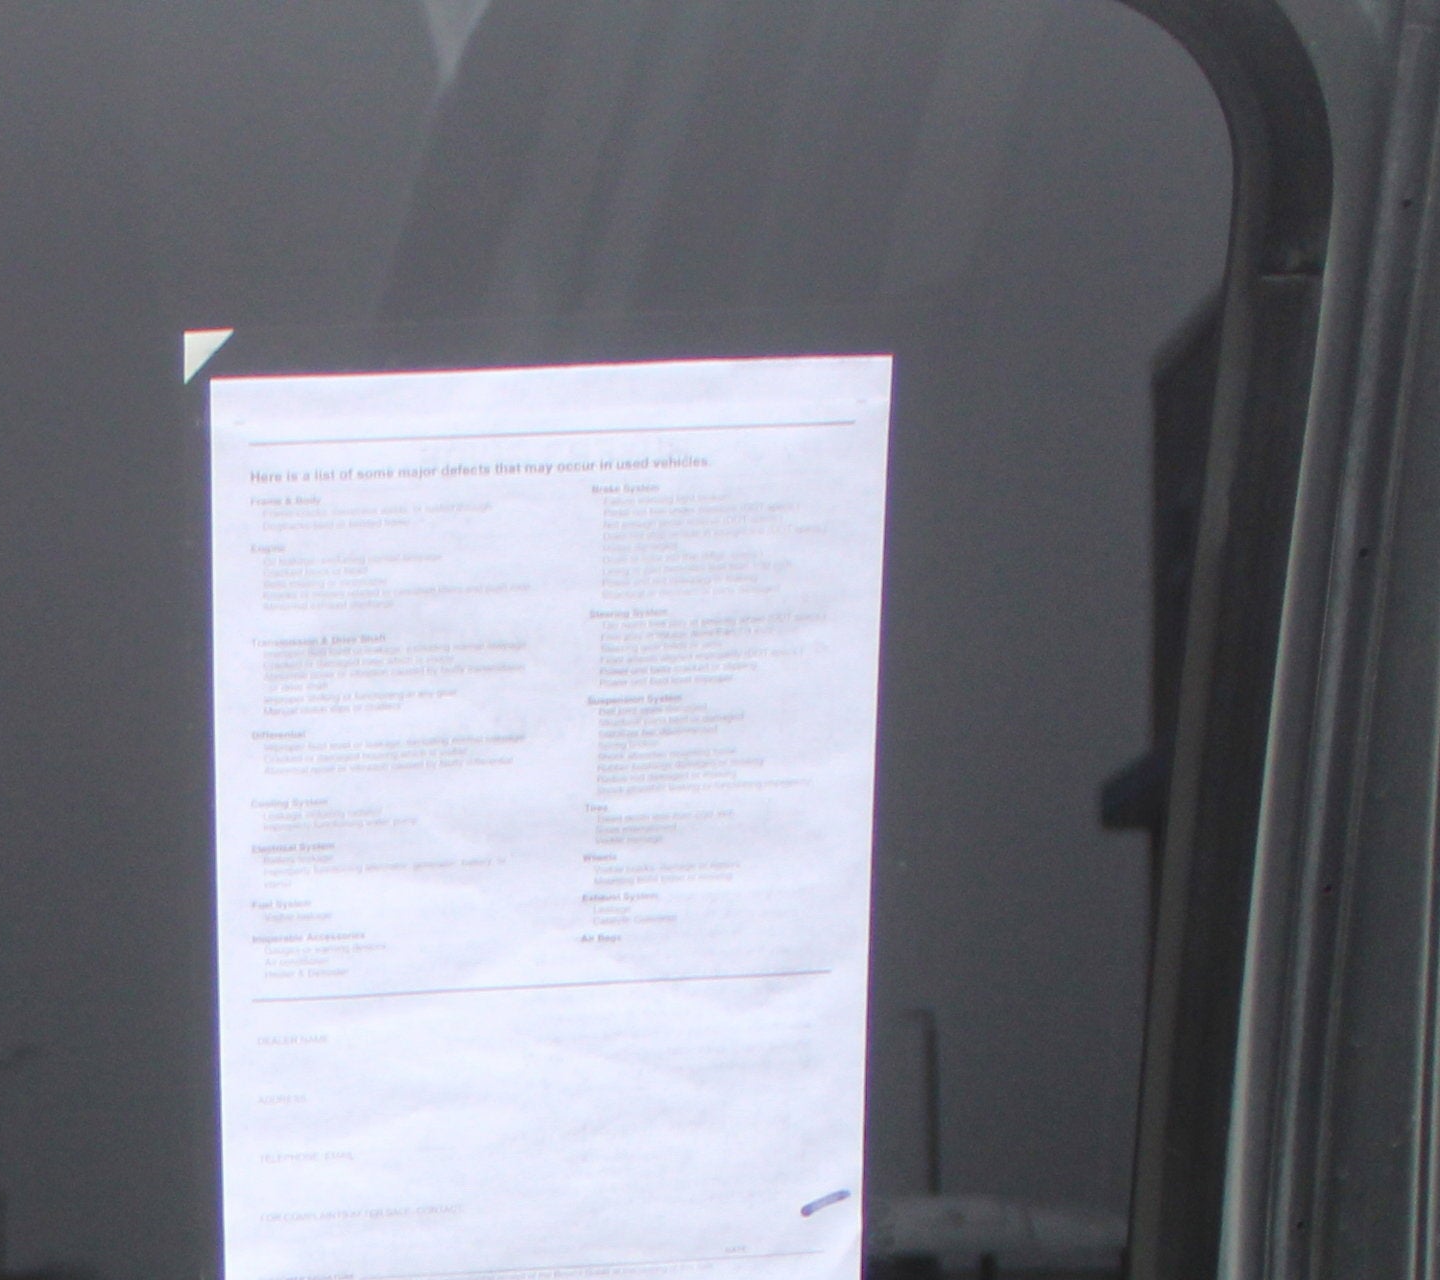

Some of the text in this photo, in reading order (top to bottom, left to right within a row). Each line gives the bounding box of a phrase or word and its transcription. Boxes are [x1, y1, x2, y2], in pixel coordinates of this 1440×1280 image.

[250, 470, 282, 483] Here
[286, 470, 298, 482] is
[303, 473, 310, 482] a
[315, 469, 335, 481] list
[340, 468, 353, 480] of
[357, 469, 393, 480] some
[398, 466, 436, 480] major
[441, 464, 490, 477] defects
[495, 463, 520, 475] that
[524, 463, 553, 475] may
[557, 462, 595, 472] occur
[599, 459, 612, 471] in
[616, 457, 649, 470] used
[591, 483, 660, 495] Brake System
[250, 495, 321, 507] Frame & Body
[250, 543, 286, 555] Engine
[587, 694, 683, 706] Suspension System
[292, 796, 328, 808] System
[299, 842, 335, 854] System
[624, 892, 658, 903] System
[251, 899, 312, 911] Fuel System
[306, 930, 366, 942] Accessories
